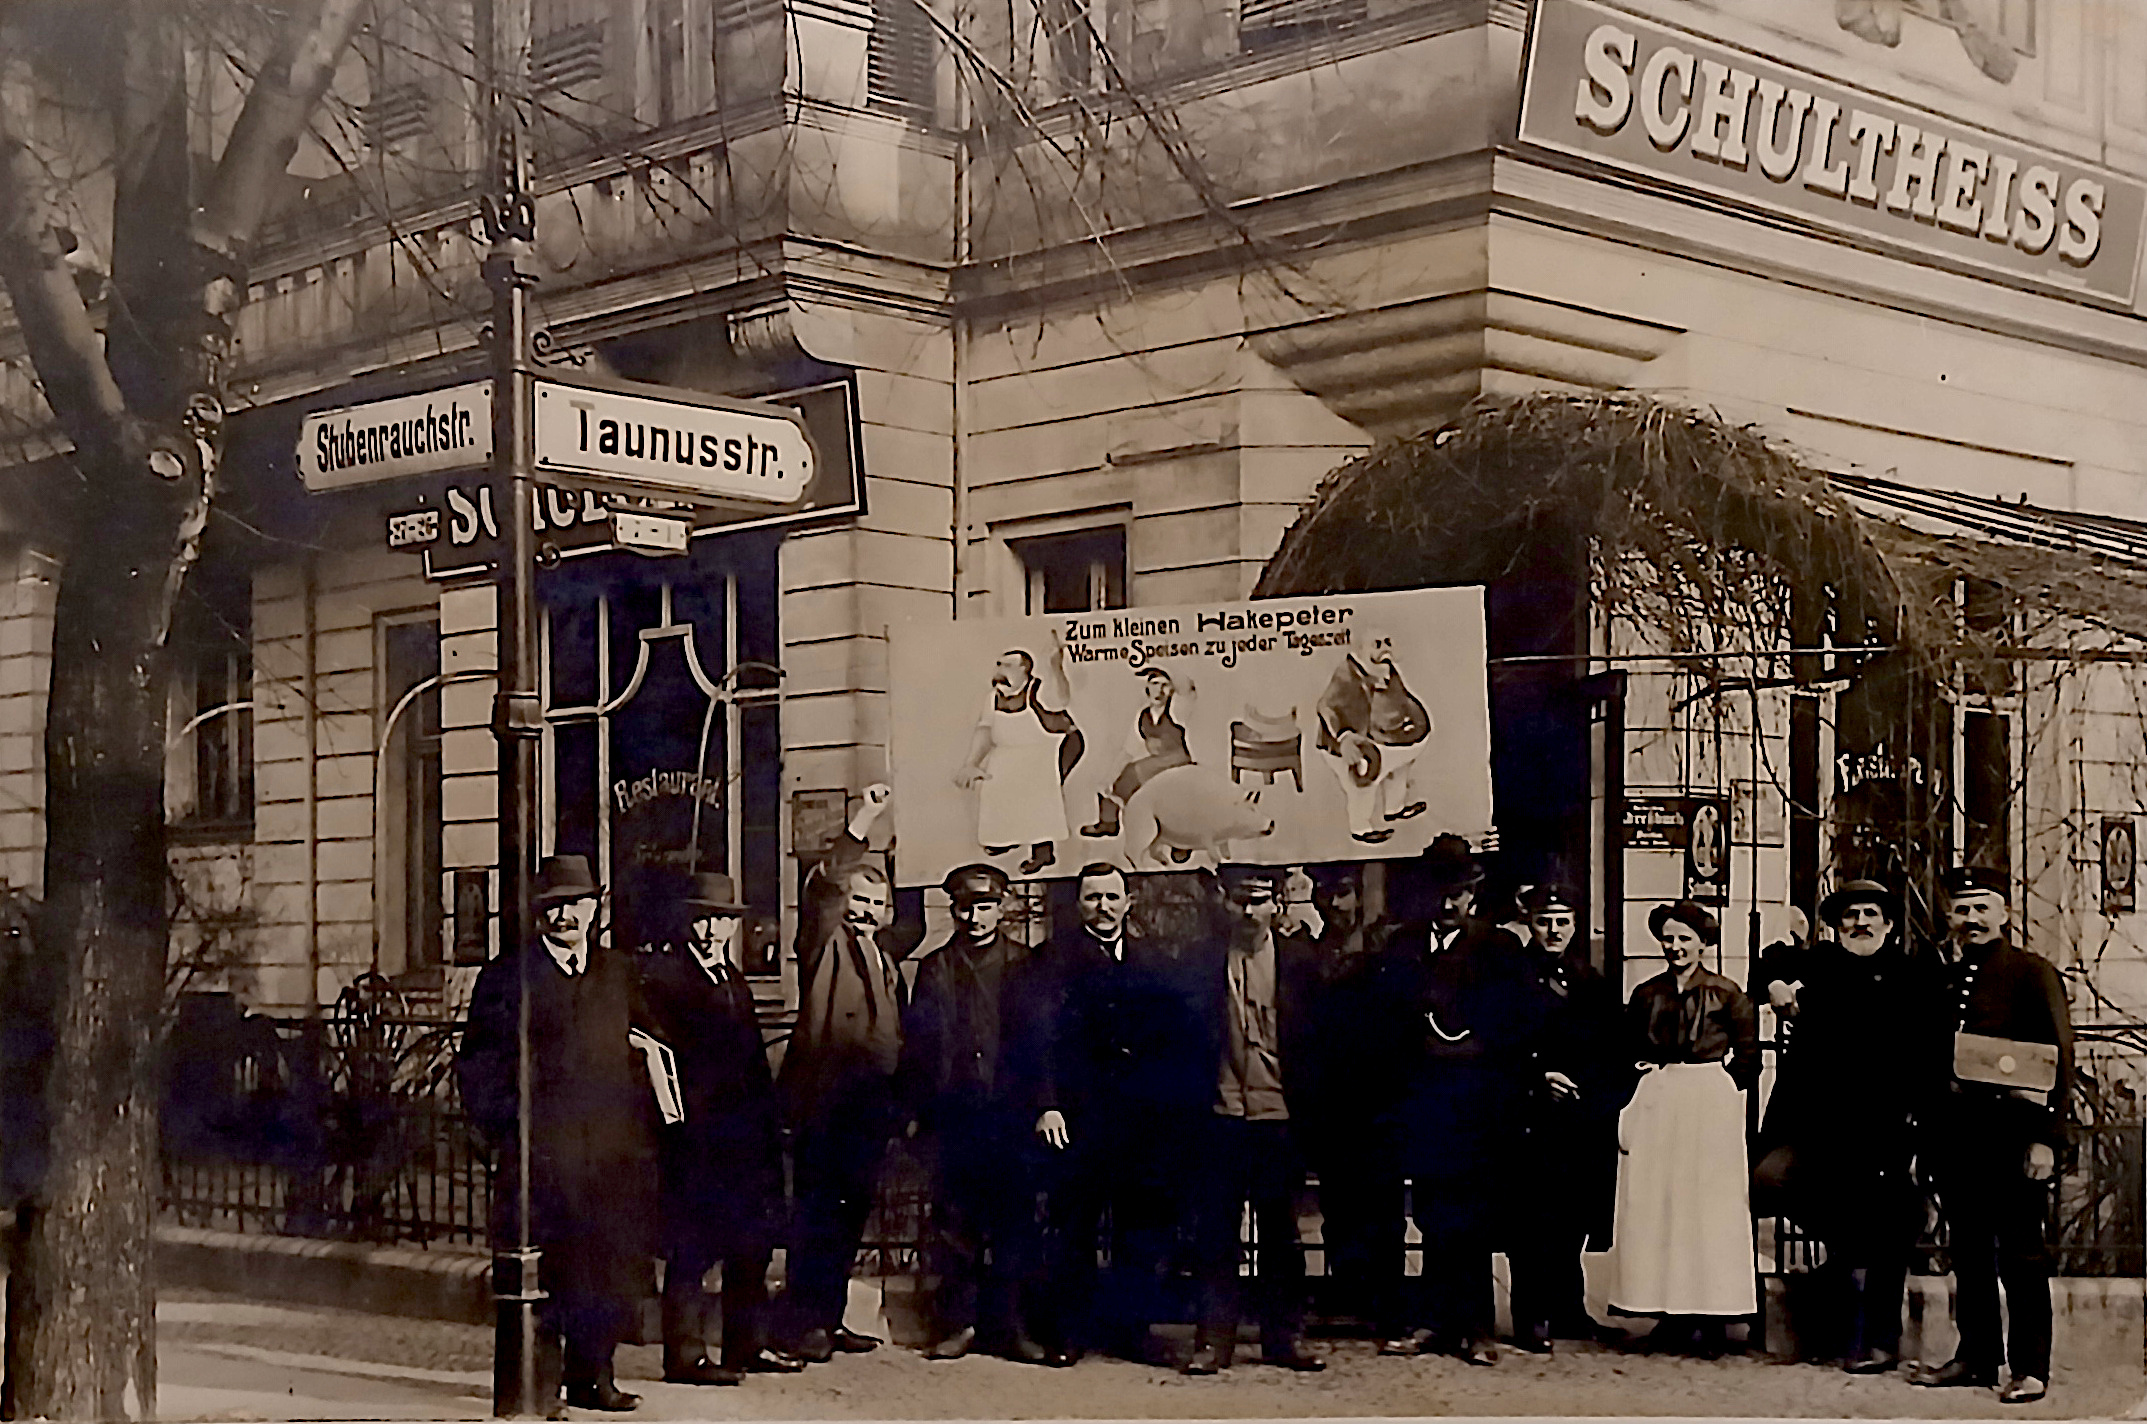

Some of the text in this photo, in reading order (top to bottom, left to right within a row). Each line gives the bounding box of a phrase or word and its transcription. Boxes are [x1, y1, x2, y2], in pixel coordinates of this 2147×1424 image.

[1575, 25, 2105, 268] SCHULTHEISS
[316, 402, 475, 473] Stubenrauchstr.
[569, 400, 785, 479] Taunusstr.
[1065, 620, 1107, 641] Zum
[1197, 605, 1354, 633] Hakepeter
[1066, 628, 1351, 669] Warme Speisen zu jeder Tageszeit
